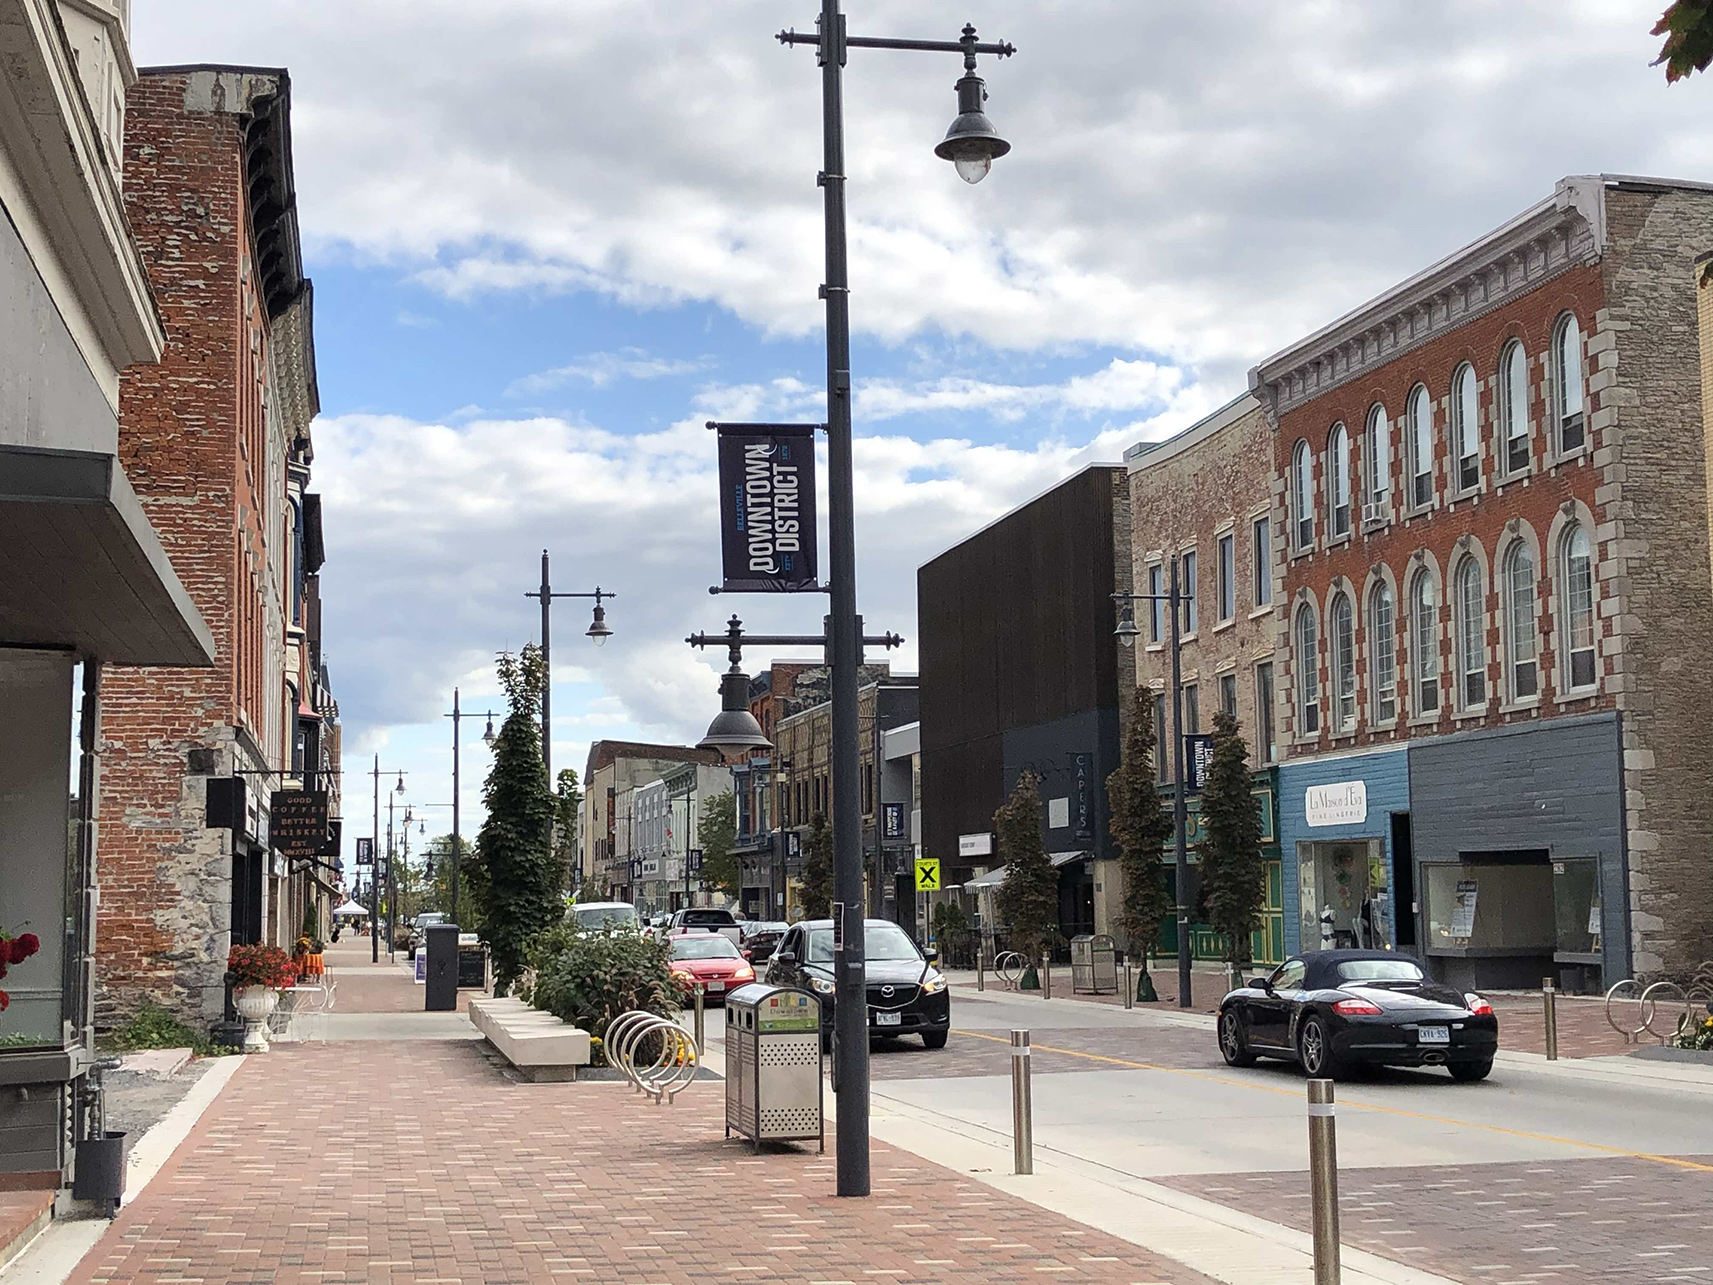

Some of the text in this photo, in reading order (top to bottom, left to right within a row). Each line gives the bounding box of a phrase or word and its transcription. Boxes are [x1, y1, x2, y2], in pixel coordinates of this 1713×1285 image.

[745, 444, 775, 572] DOWNTOWN
[773, 463, 799, 551] DISTRICT
[1076, 755, 1086, 827] CAPERS
[1194, 741, 1205, 787] DOWNTOWN
